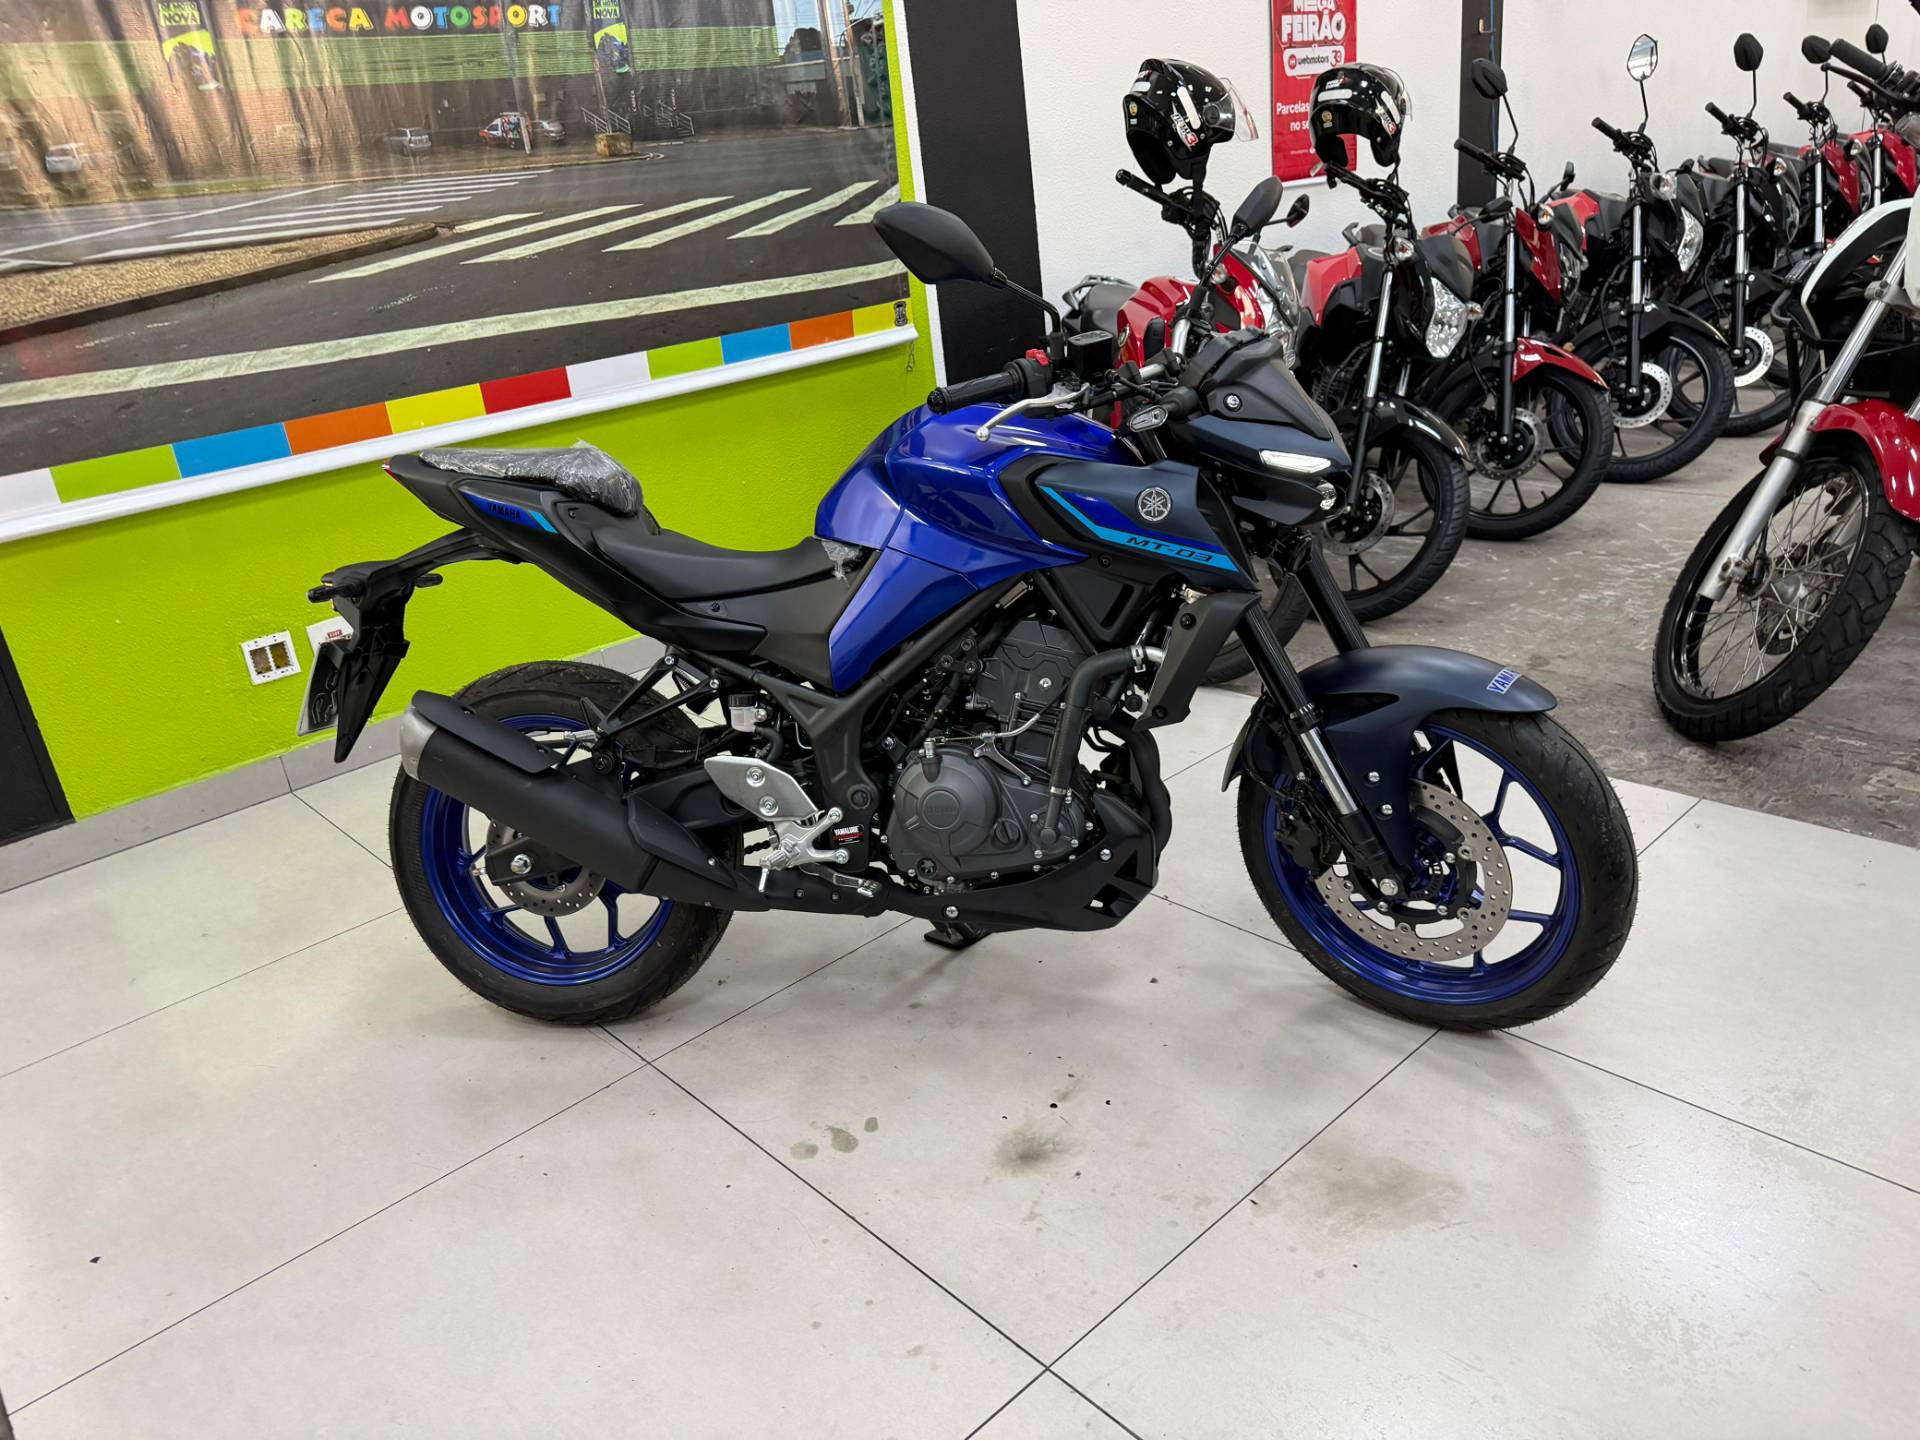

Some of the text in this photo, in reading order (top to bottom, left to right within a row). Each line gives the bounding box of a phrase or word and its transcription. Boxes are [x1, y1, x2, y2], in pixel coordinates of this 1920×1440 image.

[163, 11, 199, 25] NOVA
[239, 4, 560, 33] CARECA MOTOSPORT
[595, 8, 618, 18] NOVA
[1281, 8, 1346, 42] FEIRÃO
[1276, 99, 1310, 115] Parcelas
[1289, 121, 1301, 132] no
[488, 502, 521, 521] YAMAHA
[1126, 536, 1213, 562] MT-03
